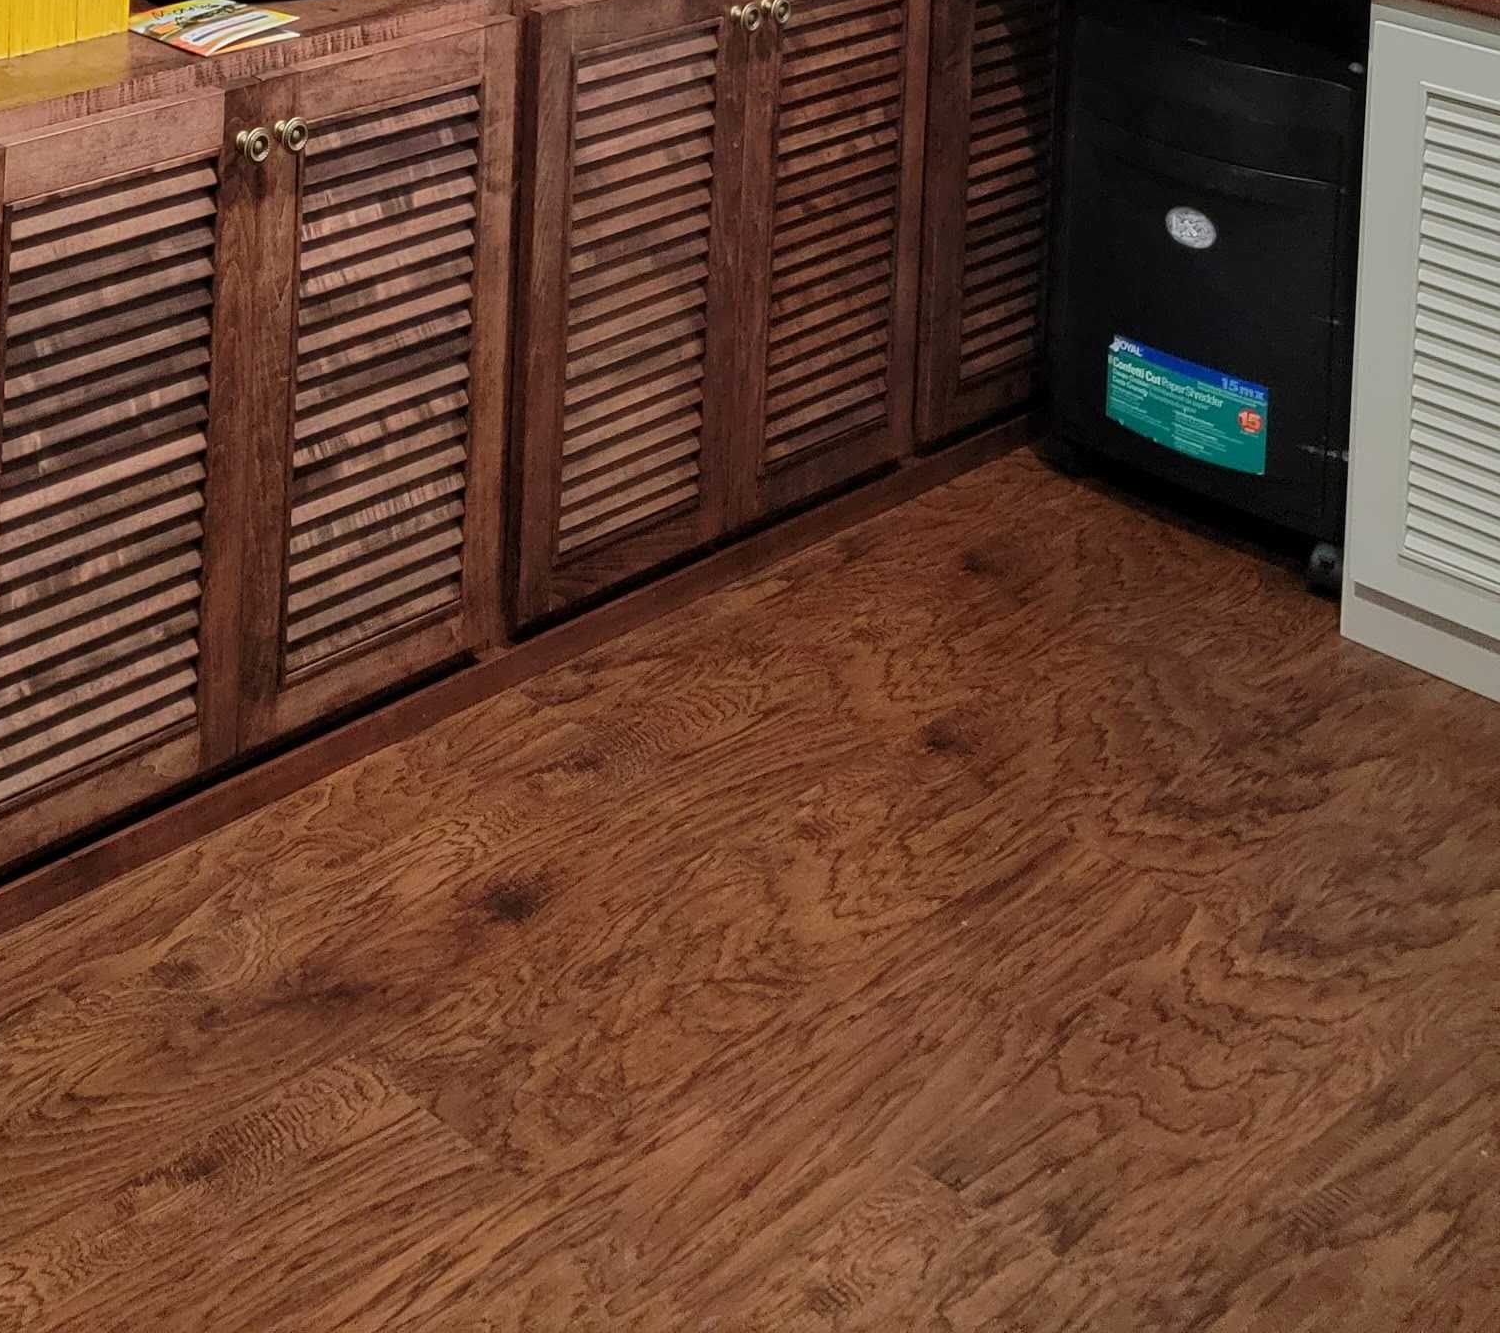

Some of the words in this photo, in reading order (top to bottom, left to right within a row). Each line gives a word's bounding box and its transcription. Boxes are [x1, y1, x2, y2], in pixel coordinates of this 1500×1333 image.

[1112, 356, 1145, 379] Confetti
[1145, 370, 1161, 386] Cut
[1238, 410, 1262, 431] 15
